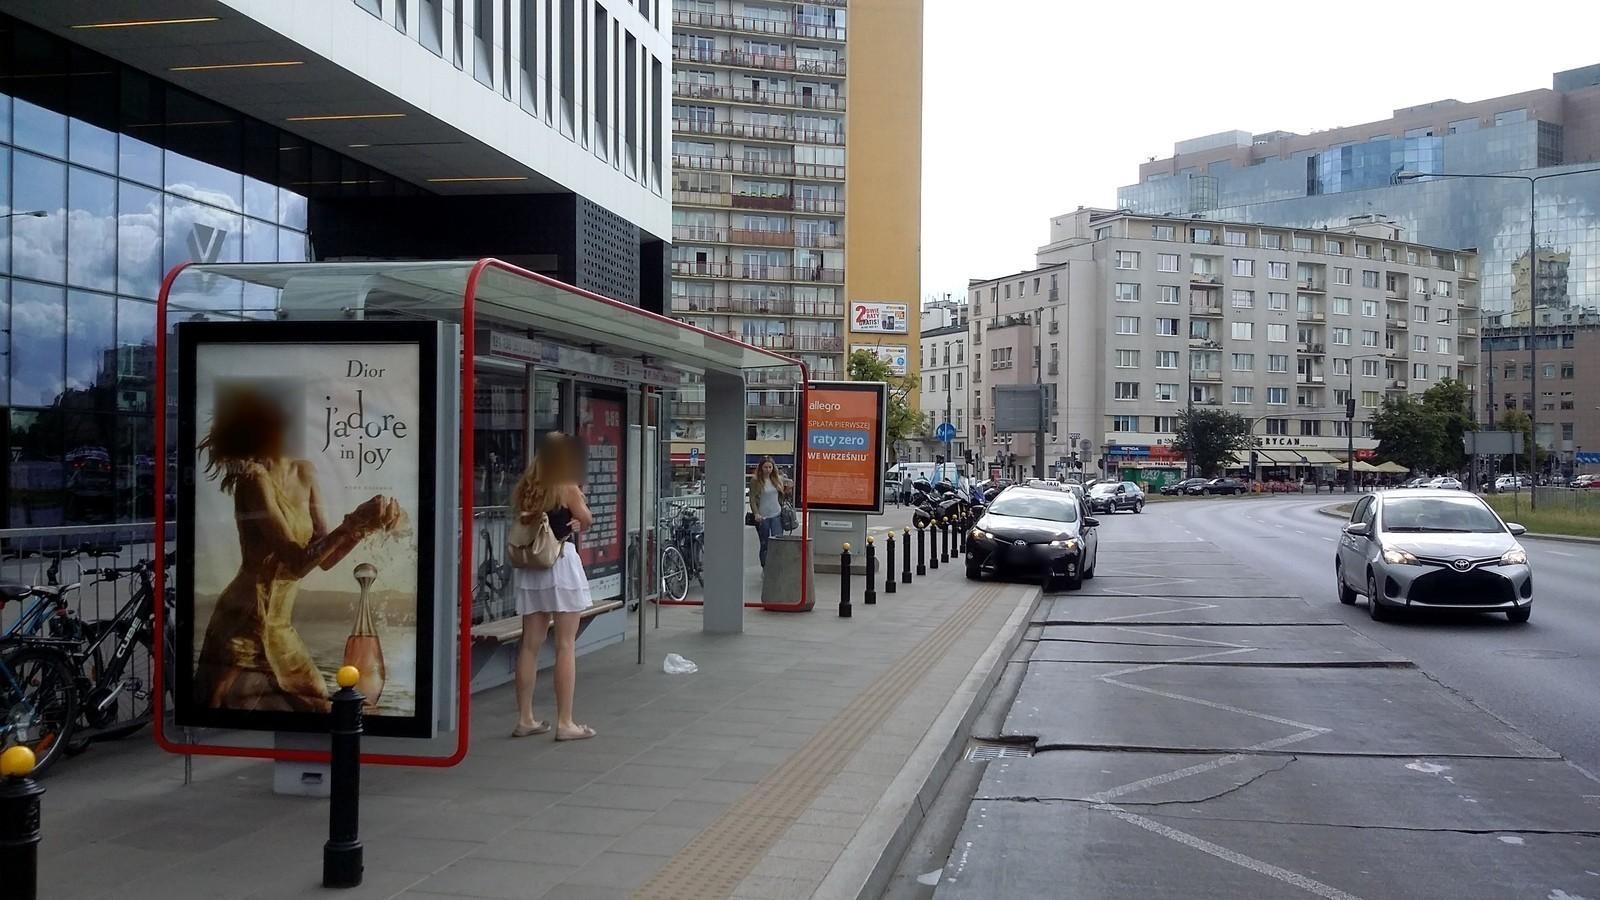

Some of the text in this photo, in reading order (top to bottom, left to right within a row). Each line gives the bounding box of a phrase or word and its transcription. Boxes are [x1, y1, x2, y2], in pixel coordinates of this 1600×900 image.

[856, 305, 867, 323] 2
[346, 359, 386, 378] Dior
[809, 401, 841, 413] allegro
[322, 389, 407, 452] j'adore
[808, 420, 870, 431] SPŁATA PIERWSZEJ
[813, 434, 865, 447] raty zero
[340, 435, 392, 478] in joy
[807, 452, 821, 460] WE
[116, 617, 142, 658] CUBE
